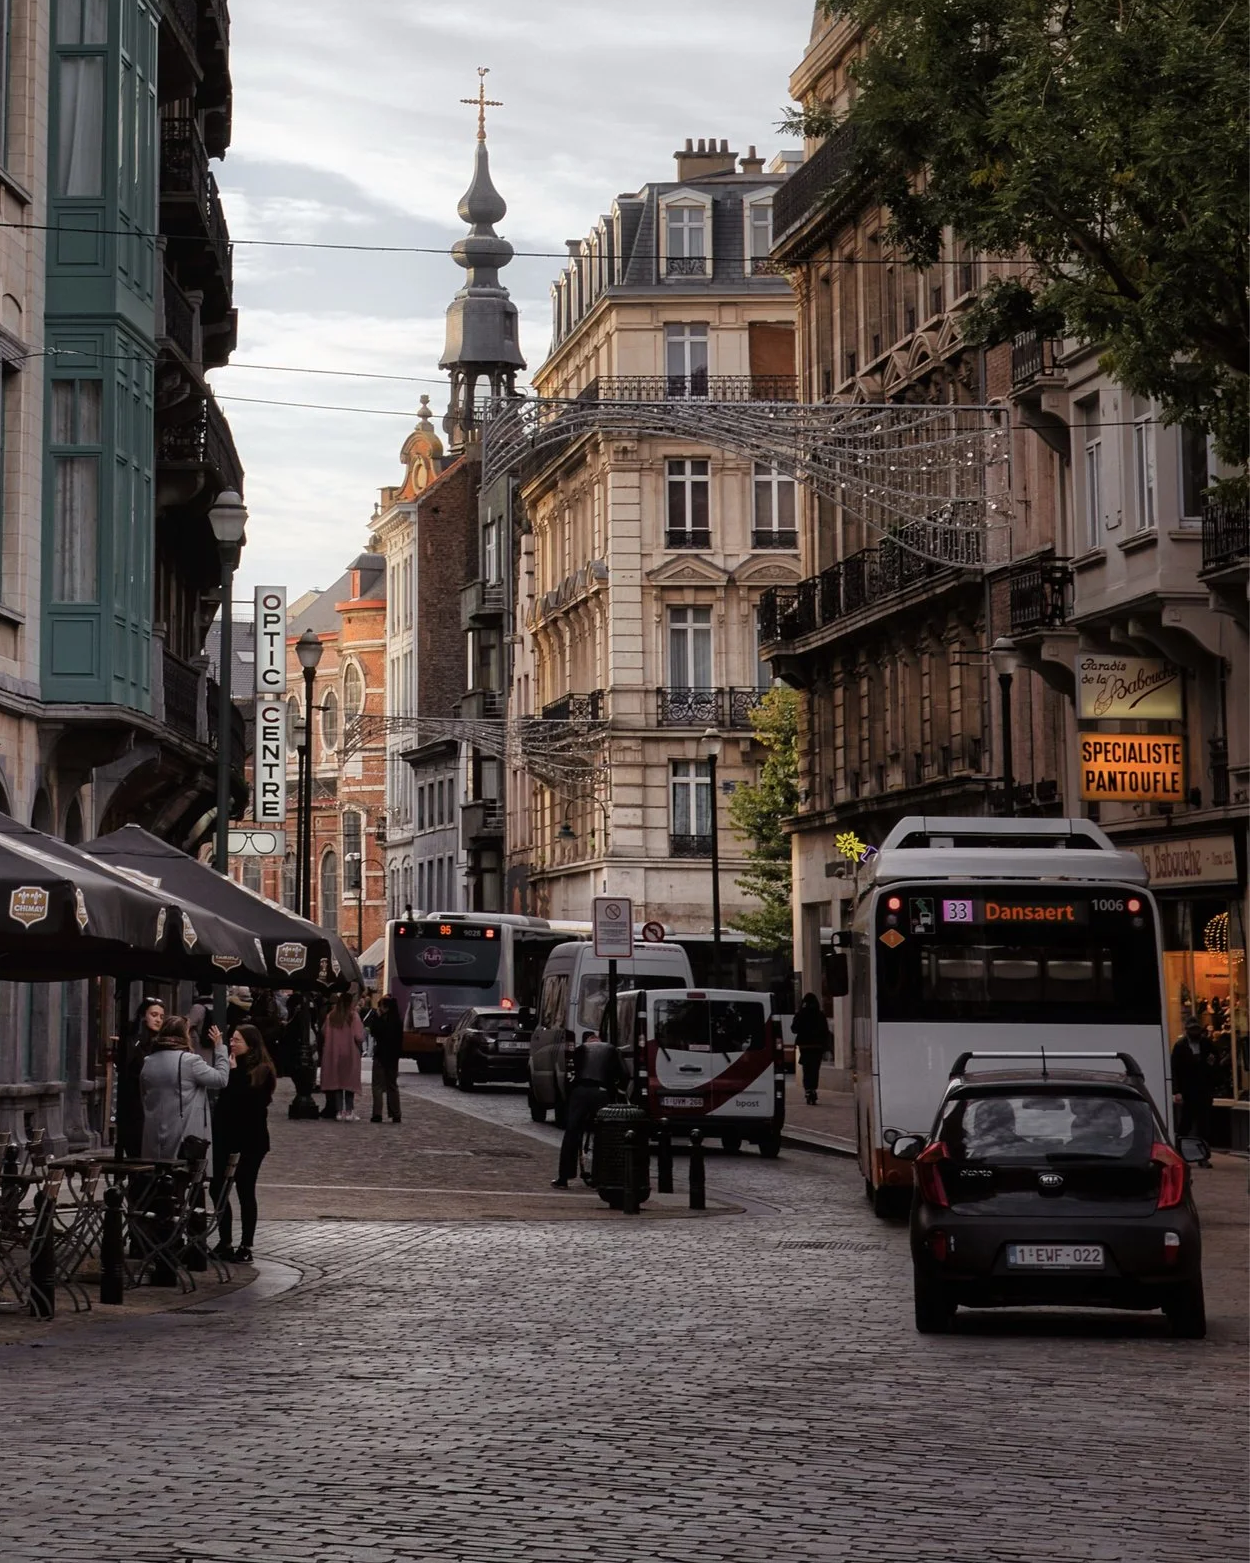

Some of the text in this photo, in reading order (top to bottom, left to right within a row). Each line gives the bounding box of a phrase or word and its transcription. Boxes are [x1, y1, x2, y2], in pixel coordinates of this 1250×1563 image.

[262, 594, 282, 685] OPTIC
[1081, 658, 1126, 671] Paradis
[1081, 660, 1179, 699] de la Babouche
[1082, 741, 1181, 765] SPECIALISTE
[261, 706, 281, 817] CENTRE
[1085, 770, 1180, 794] PANTOUFLE
[1153, 842, 1202, 878] Babouche
[14, 904, 45, 913] CHIMAY
[949, 902, 1075, 921] 33 Dansaert
[1091, 899, 1125, 912] 1006
[439, 925, 452, 936] 95
[462, 929, 482, 938] 9028
[279, 956, 304, 964] CHIMAY
[423, 951, 442, 961] fun
[735, 1099, 760, 1108] bpost
[1041, 1175, 1060, 1183] KIA
[1019, 1248, 1101, 1263] 1-EWF-022
